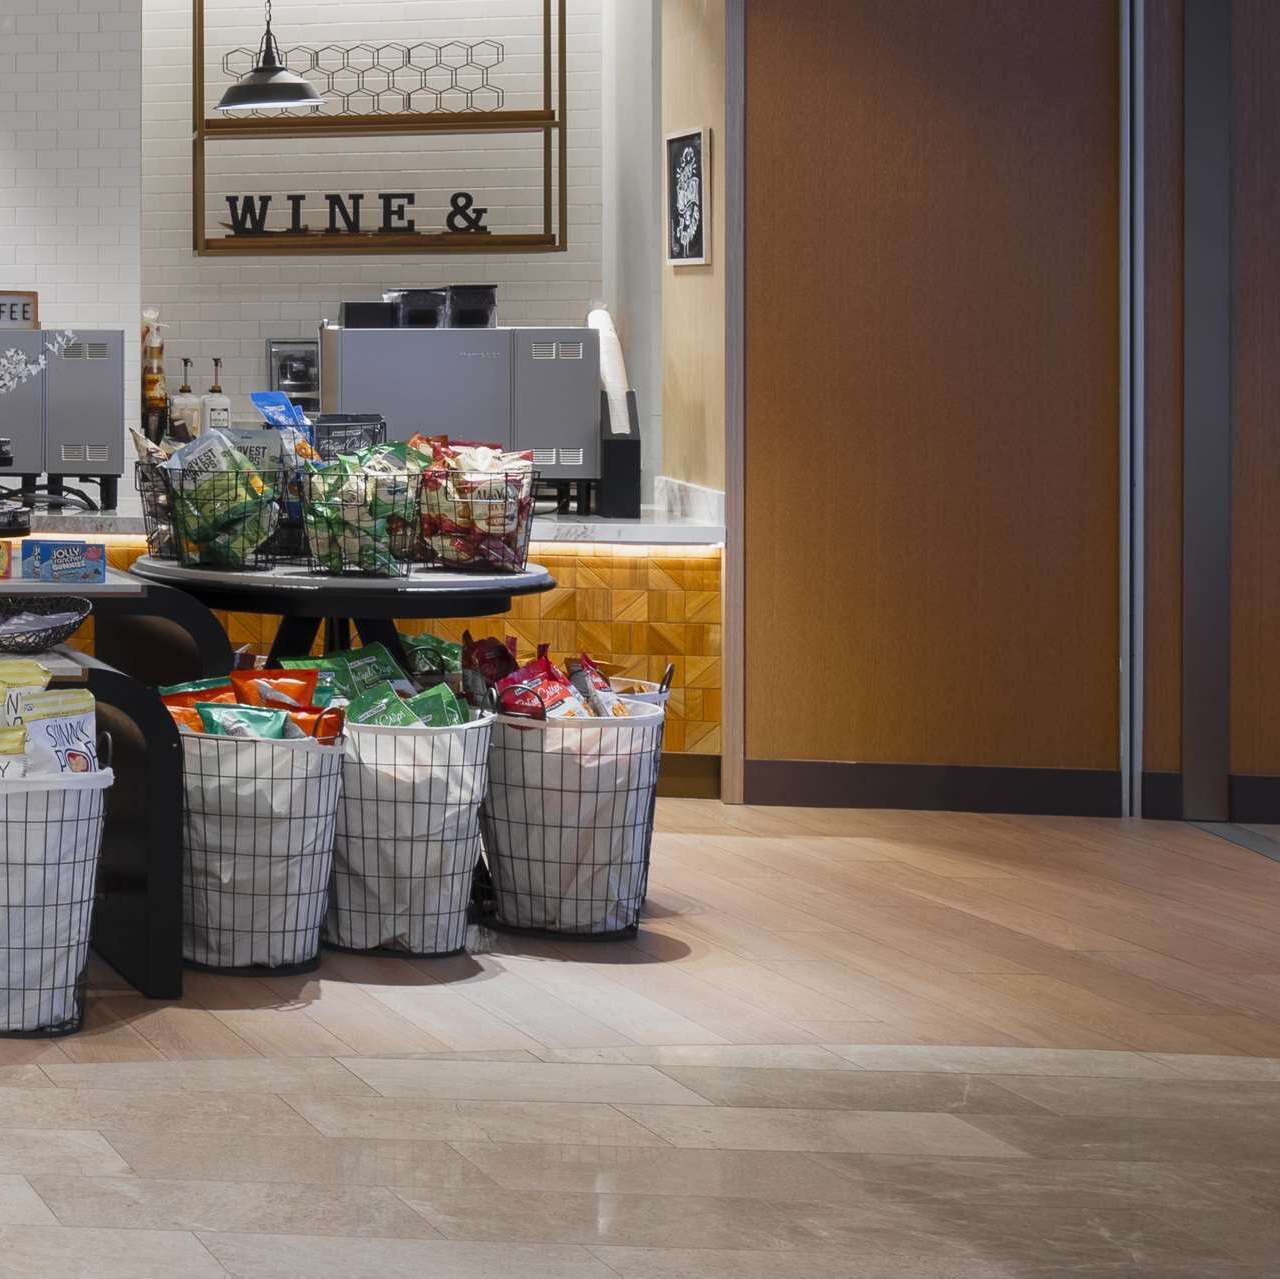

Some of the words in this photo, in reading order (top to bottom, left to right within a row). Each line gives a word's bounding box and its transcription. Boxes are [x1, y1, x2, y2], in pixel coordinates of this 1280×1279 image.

[225, 193, 415, 234] WINE
[446, 191, 488, 233] &
[52, 547, 81, 559] JOLLY
